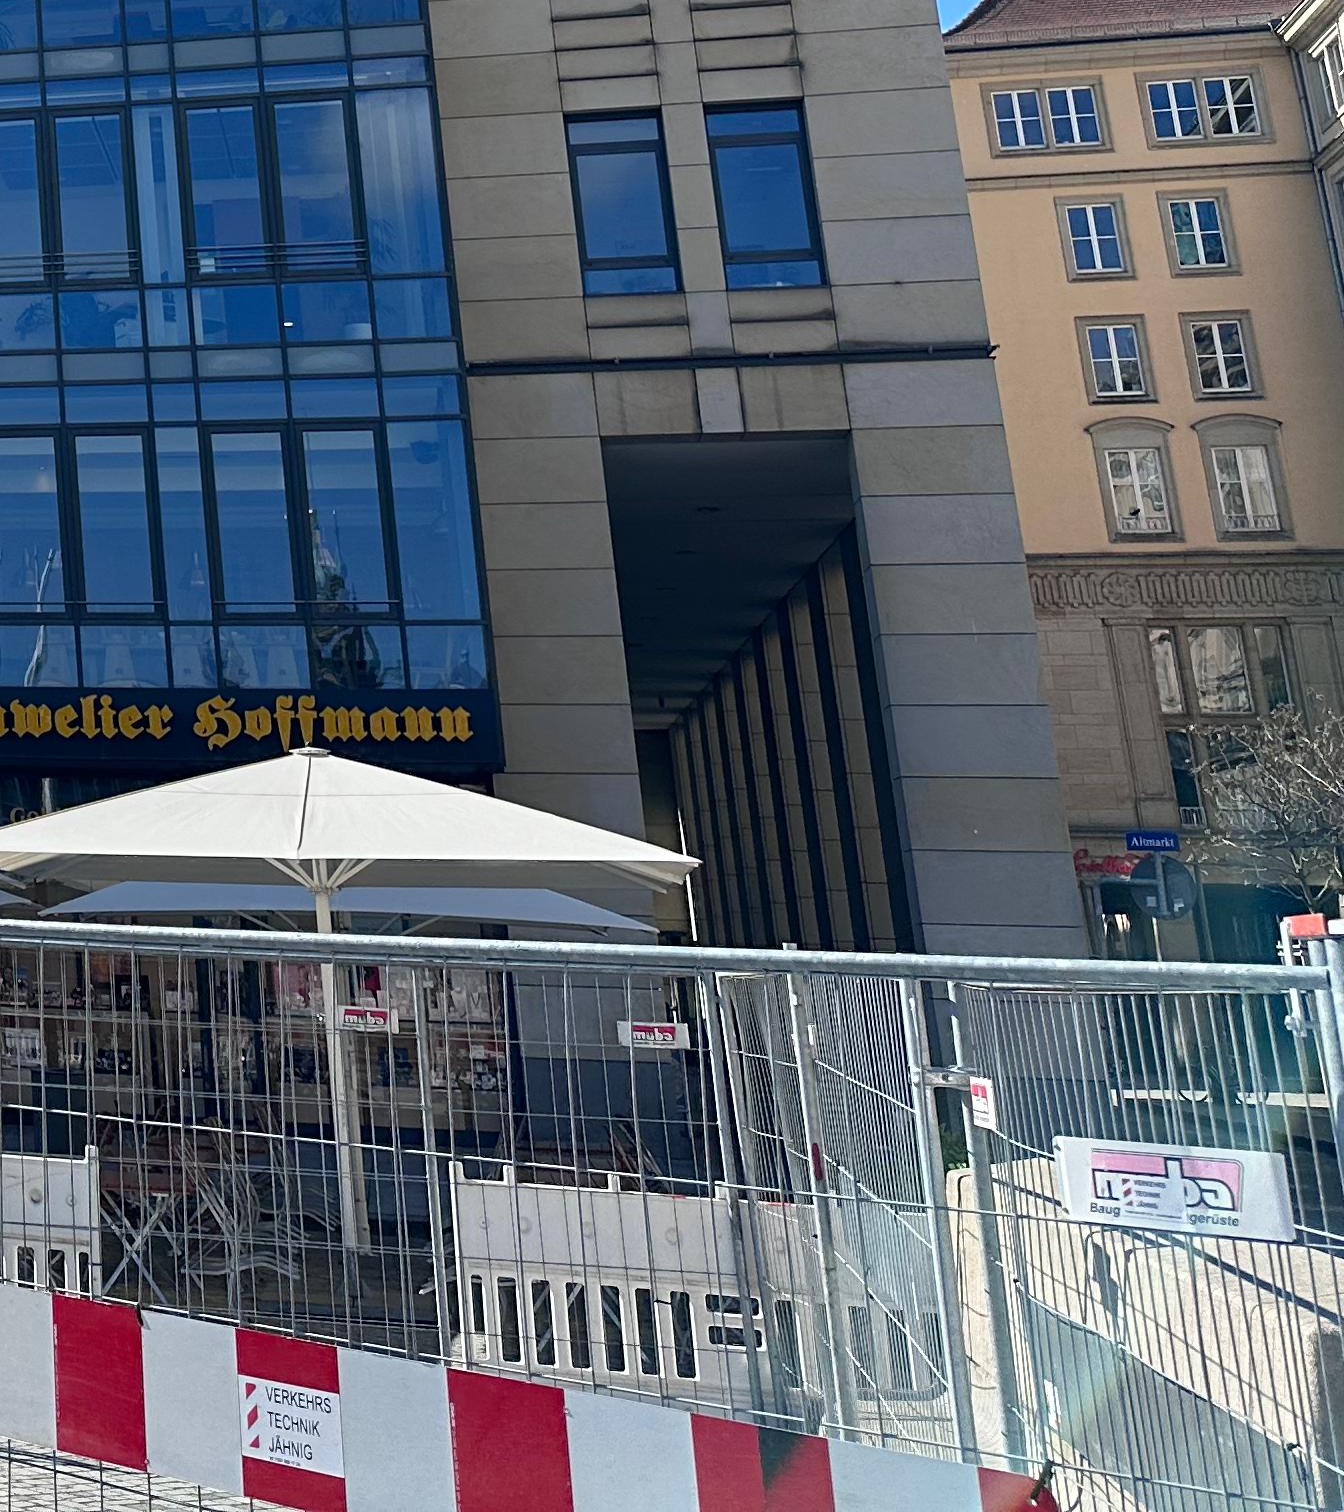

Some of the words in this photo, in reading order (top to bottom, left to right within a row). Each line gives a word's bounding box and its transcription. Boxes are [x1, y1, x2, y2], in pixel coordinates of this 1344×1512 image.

[192, 694, 474, 752] Hoffmann
[1131, 835, 1175, 847] Altmarkt
[265, 1385, 332, 1414] VERKEHRS
[267, 1410, 321, 1438] TECHNIK
[268, 1434, 313, 1461] JÄHNIG
